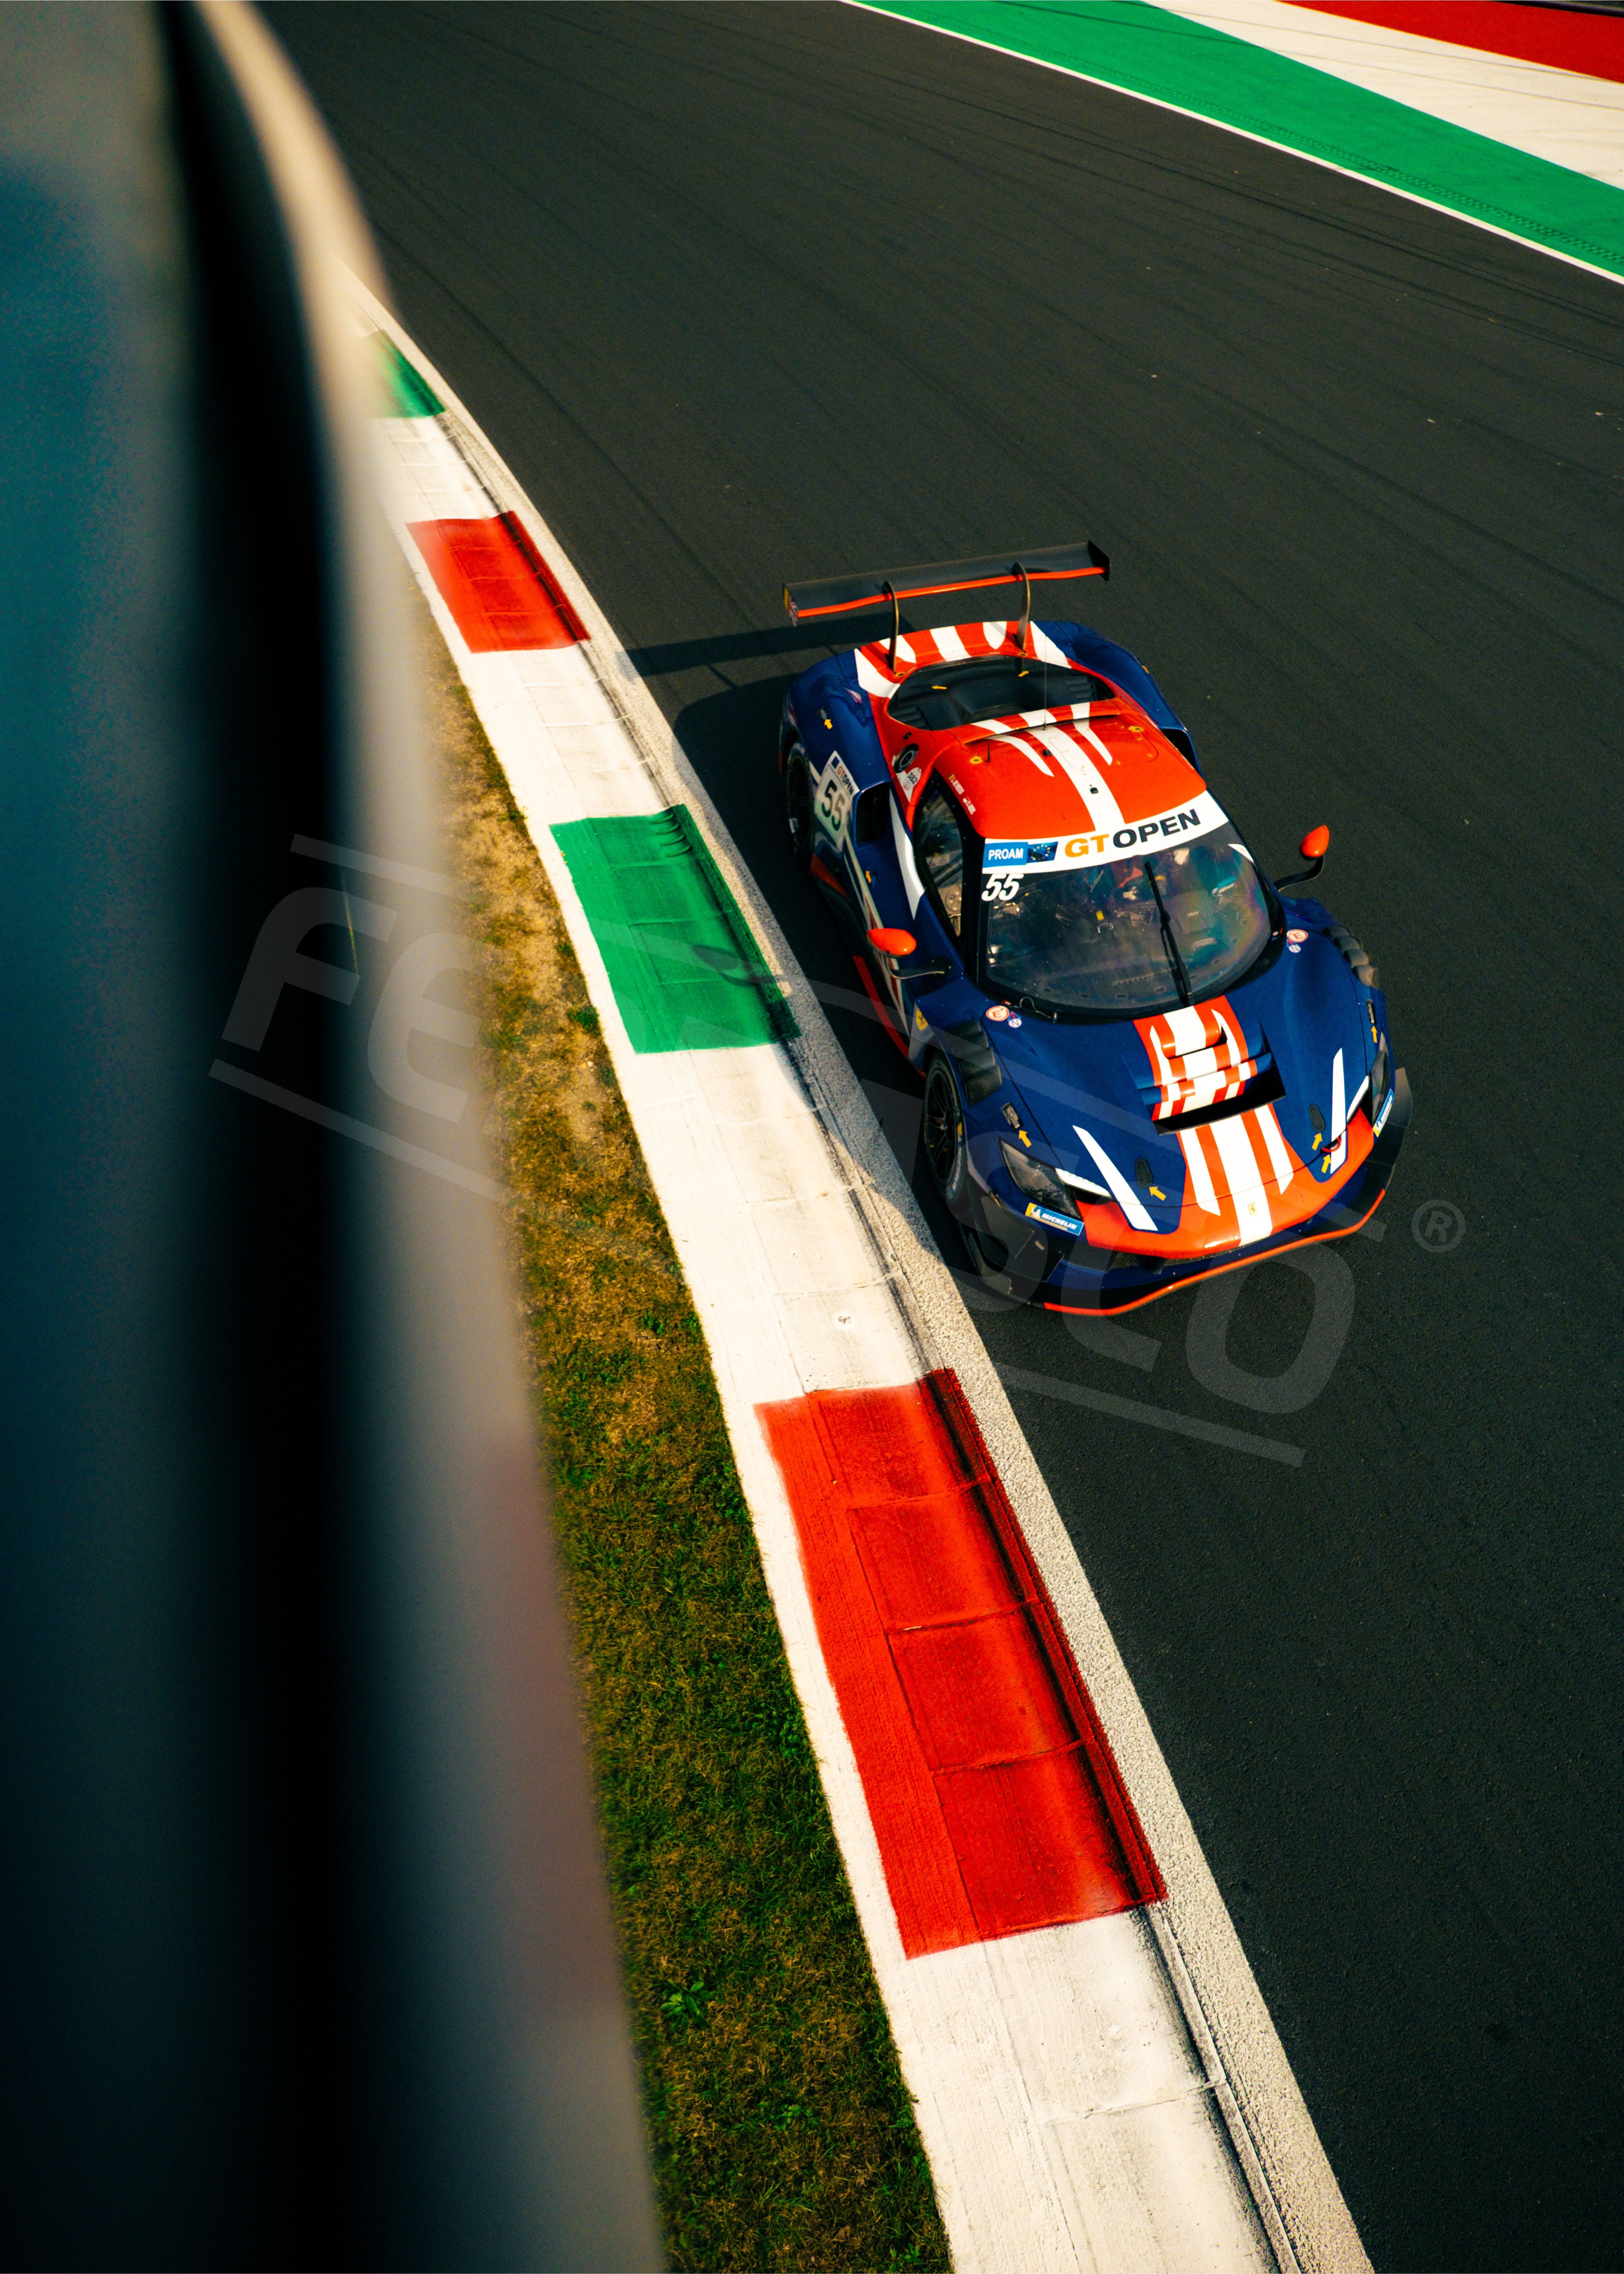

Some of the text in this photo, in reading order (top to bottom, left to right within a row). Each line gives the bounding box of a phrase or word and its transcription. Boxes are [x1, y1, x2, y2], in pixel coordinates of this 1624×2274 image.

[821, 779, 845, 831] 55
[988, 848, 1023, 861] PROAM
[981, 873, 1024, 901] 55
[1041, 1213, 1077, 1230] MICHELIN
